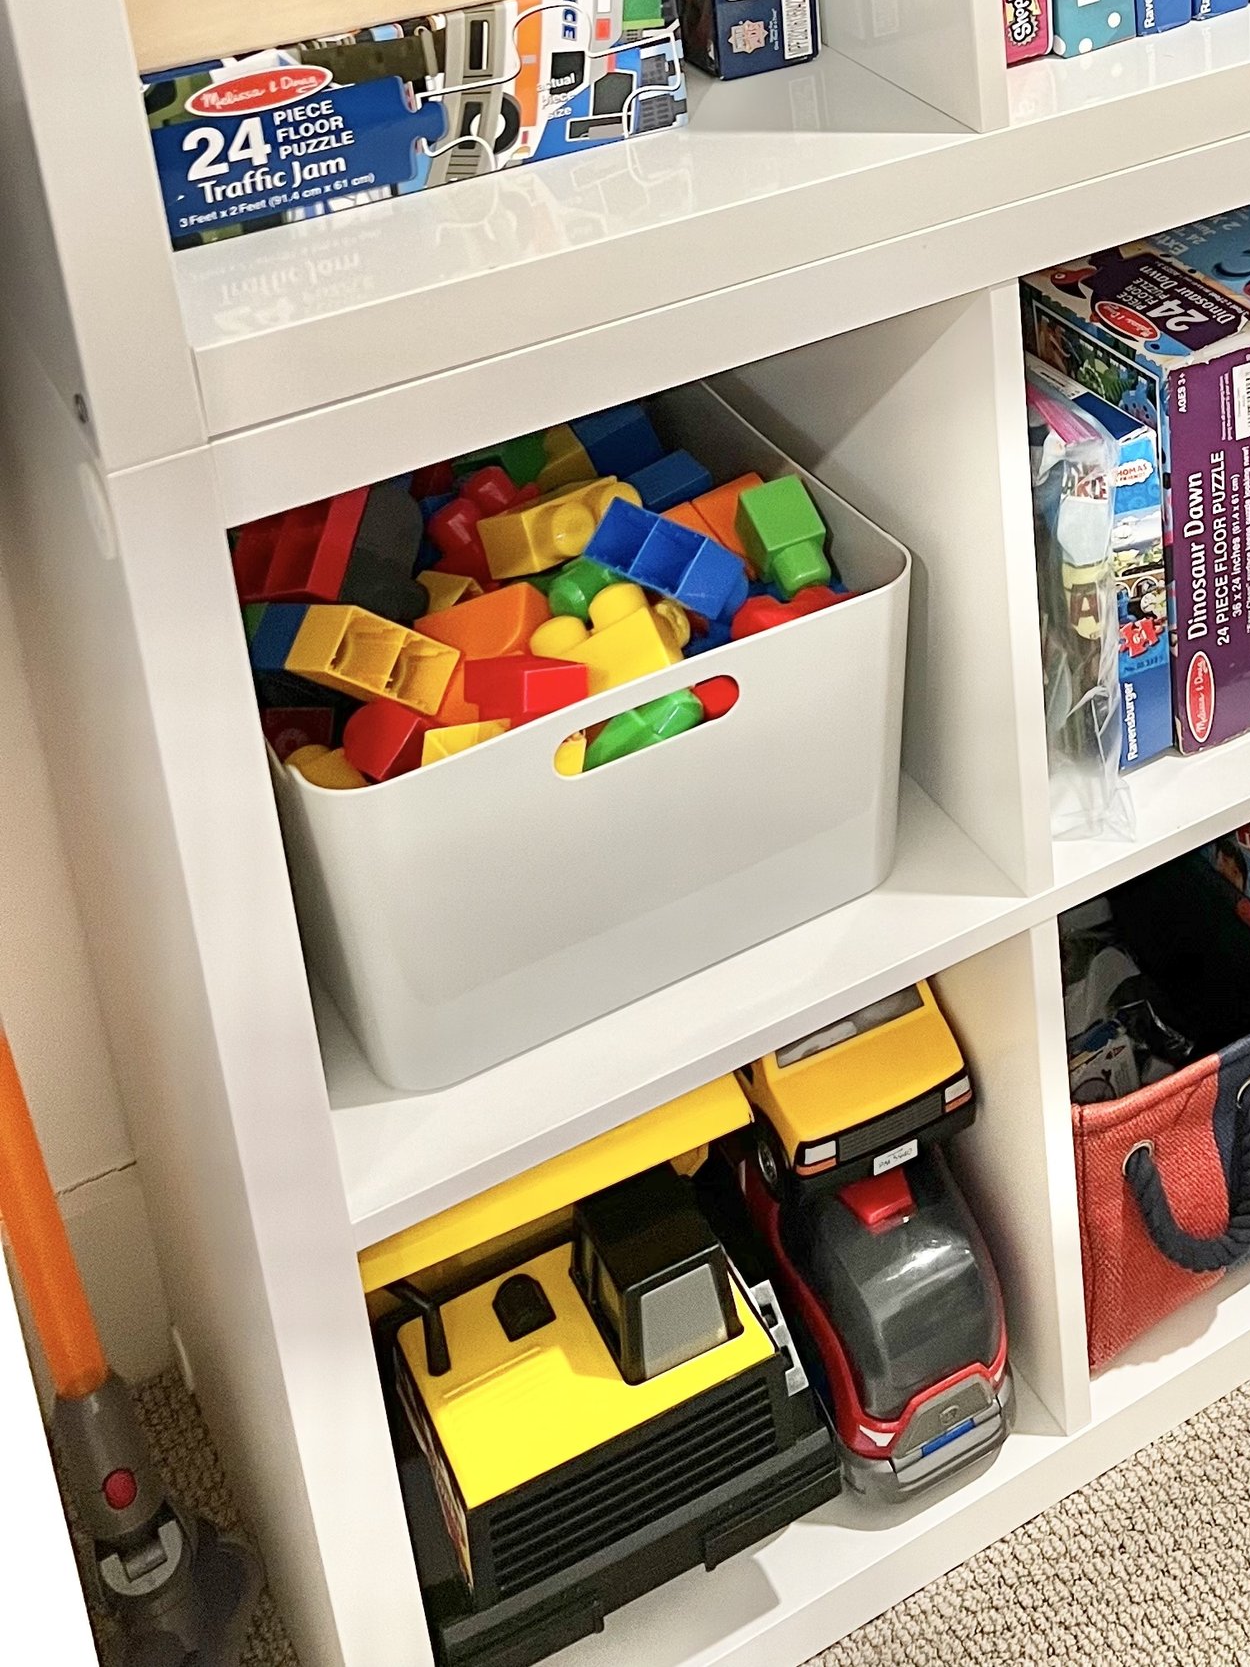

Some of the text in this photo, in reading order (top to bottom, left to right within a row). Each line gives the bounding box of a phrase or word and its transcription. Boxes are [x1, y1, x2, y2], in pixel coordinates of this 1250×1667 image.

[535, 72, 576, 93] actual
[273, 100, 334, 125] PIECE
[541, 91, 576, 110] piece
[546, 104, 572, 121] size
[275, 116, 345, 144] FLOOR
[181, 118, 271, 182] 24
[278, 131, 354, 161] PUZZLE
[197, 153, 346, 206] Traffic Jam
[180, 215, 188, 229] 3
[189, 210, 218, 227] Feet
[229, 204, 238, 217] 2
[239, 199, 267, 216] Feet
[269, 191, 300, 210] (91.4
[303, 188, 319, 200] cm
[334, 178, 349, 193] 61
[351, 172, 375, 192] cm)
[1116, 291, 1148, 311] PIECE
[1124, 284, 1159, 306] FLOOR
[1132, 277, 1170, 300] PUZZLE
[1140, 265, 1236, 325] Dinosaur Dawn
[1146, 299, 1210, 332] 24
[1211, 451, 1226, 514] PUZZLE
[1184, 472, 1208, 640] Dinosaur Dawn
[1213, 517, 1228, 572] FLOOR
[1215, 576, 1229, 624] PIECE
[1217, 627, 1230, 646] 24
[1124, 682, 1138, 761] Ravensburger
